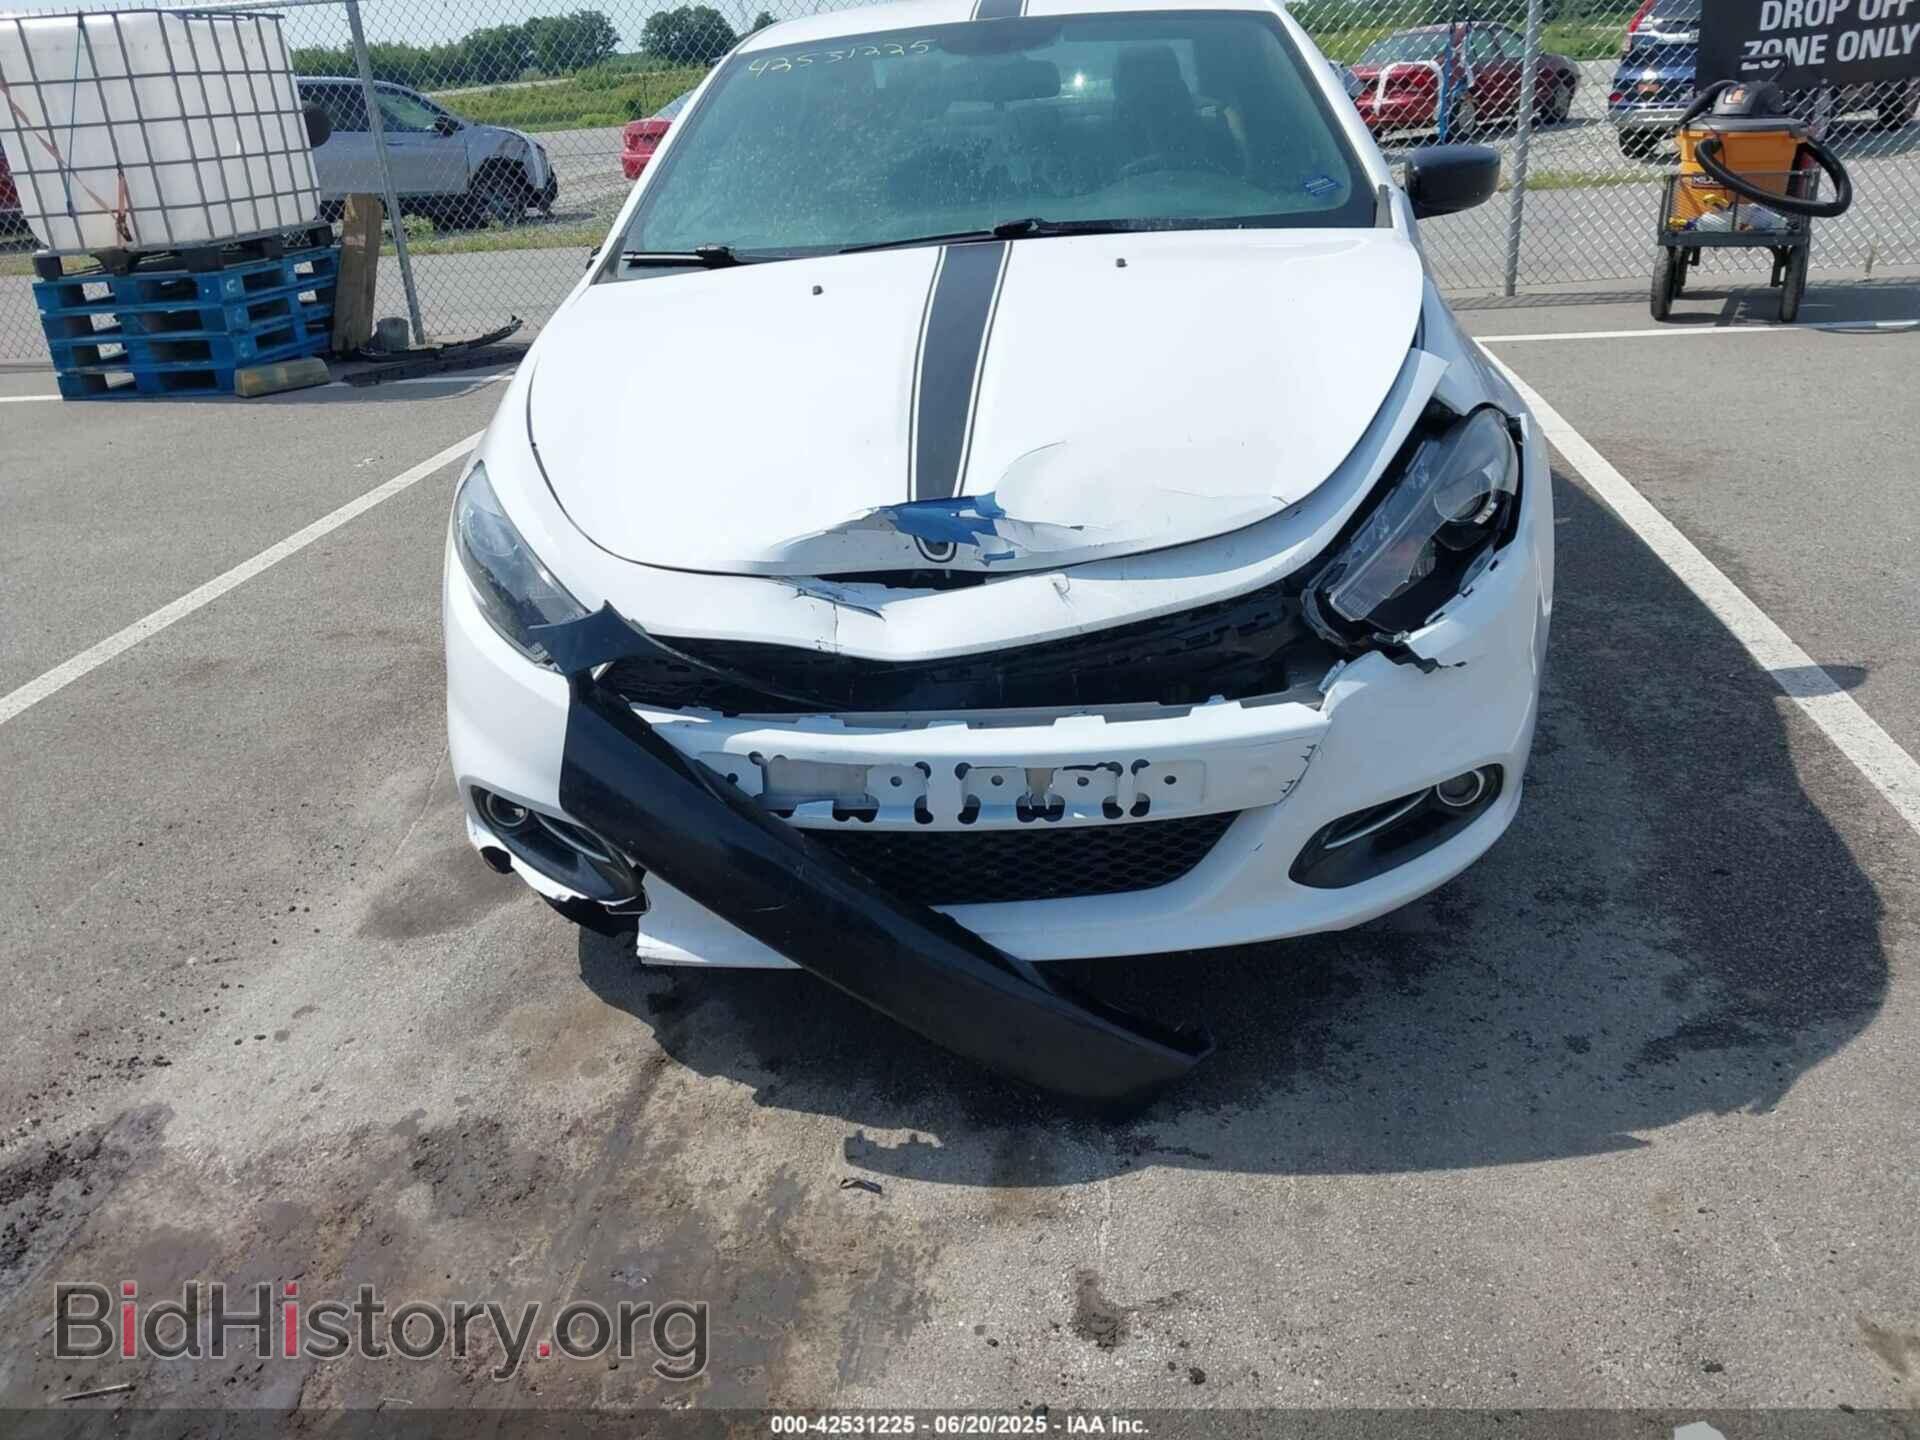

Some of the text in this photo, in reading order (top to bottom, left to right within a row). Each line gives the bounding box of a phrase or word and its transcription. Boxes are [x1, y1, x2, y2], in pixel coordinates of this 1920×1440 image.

[1759, 0, 1849, 31] DROP
[1741, 23, 1920, 71] ZONE ONLY
